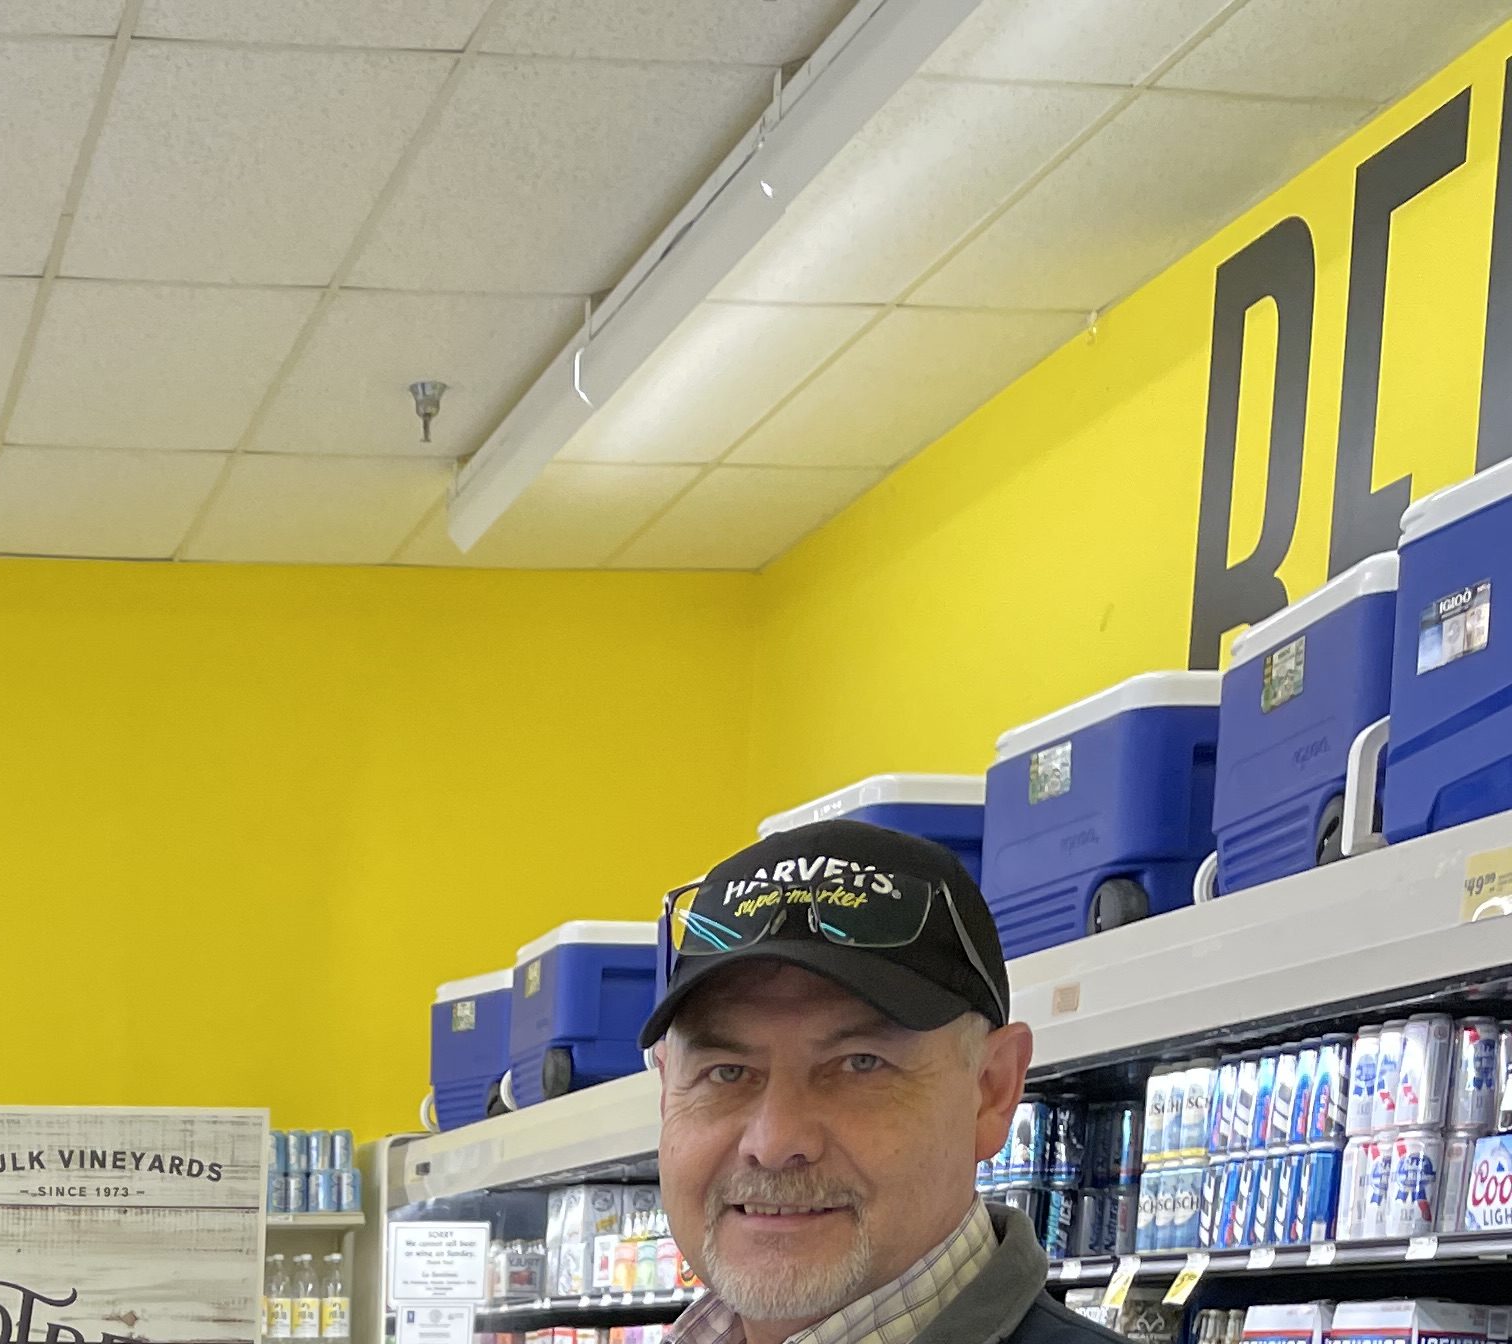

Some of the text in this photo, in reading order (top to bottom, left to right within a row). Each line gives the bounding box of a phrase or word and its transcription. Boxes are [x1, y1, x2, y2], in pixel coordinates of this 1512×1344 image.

[58, 1150, 223, 1182] VINEYARDS
[38, 1186, 130, 1197] SINCE 1973
